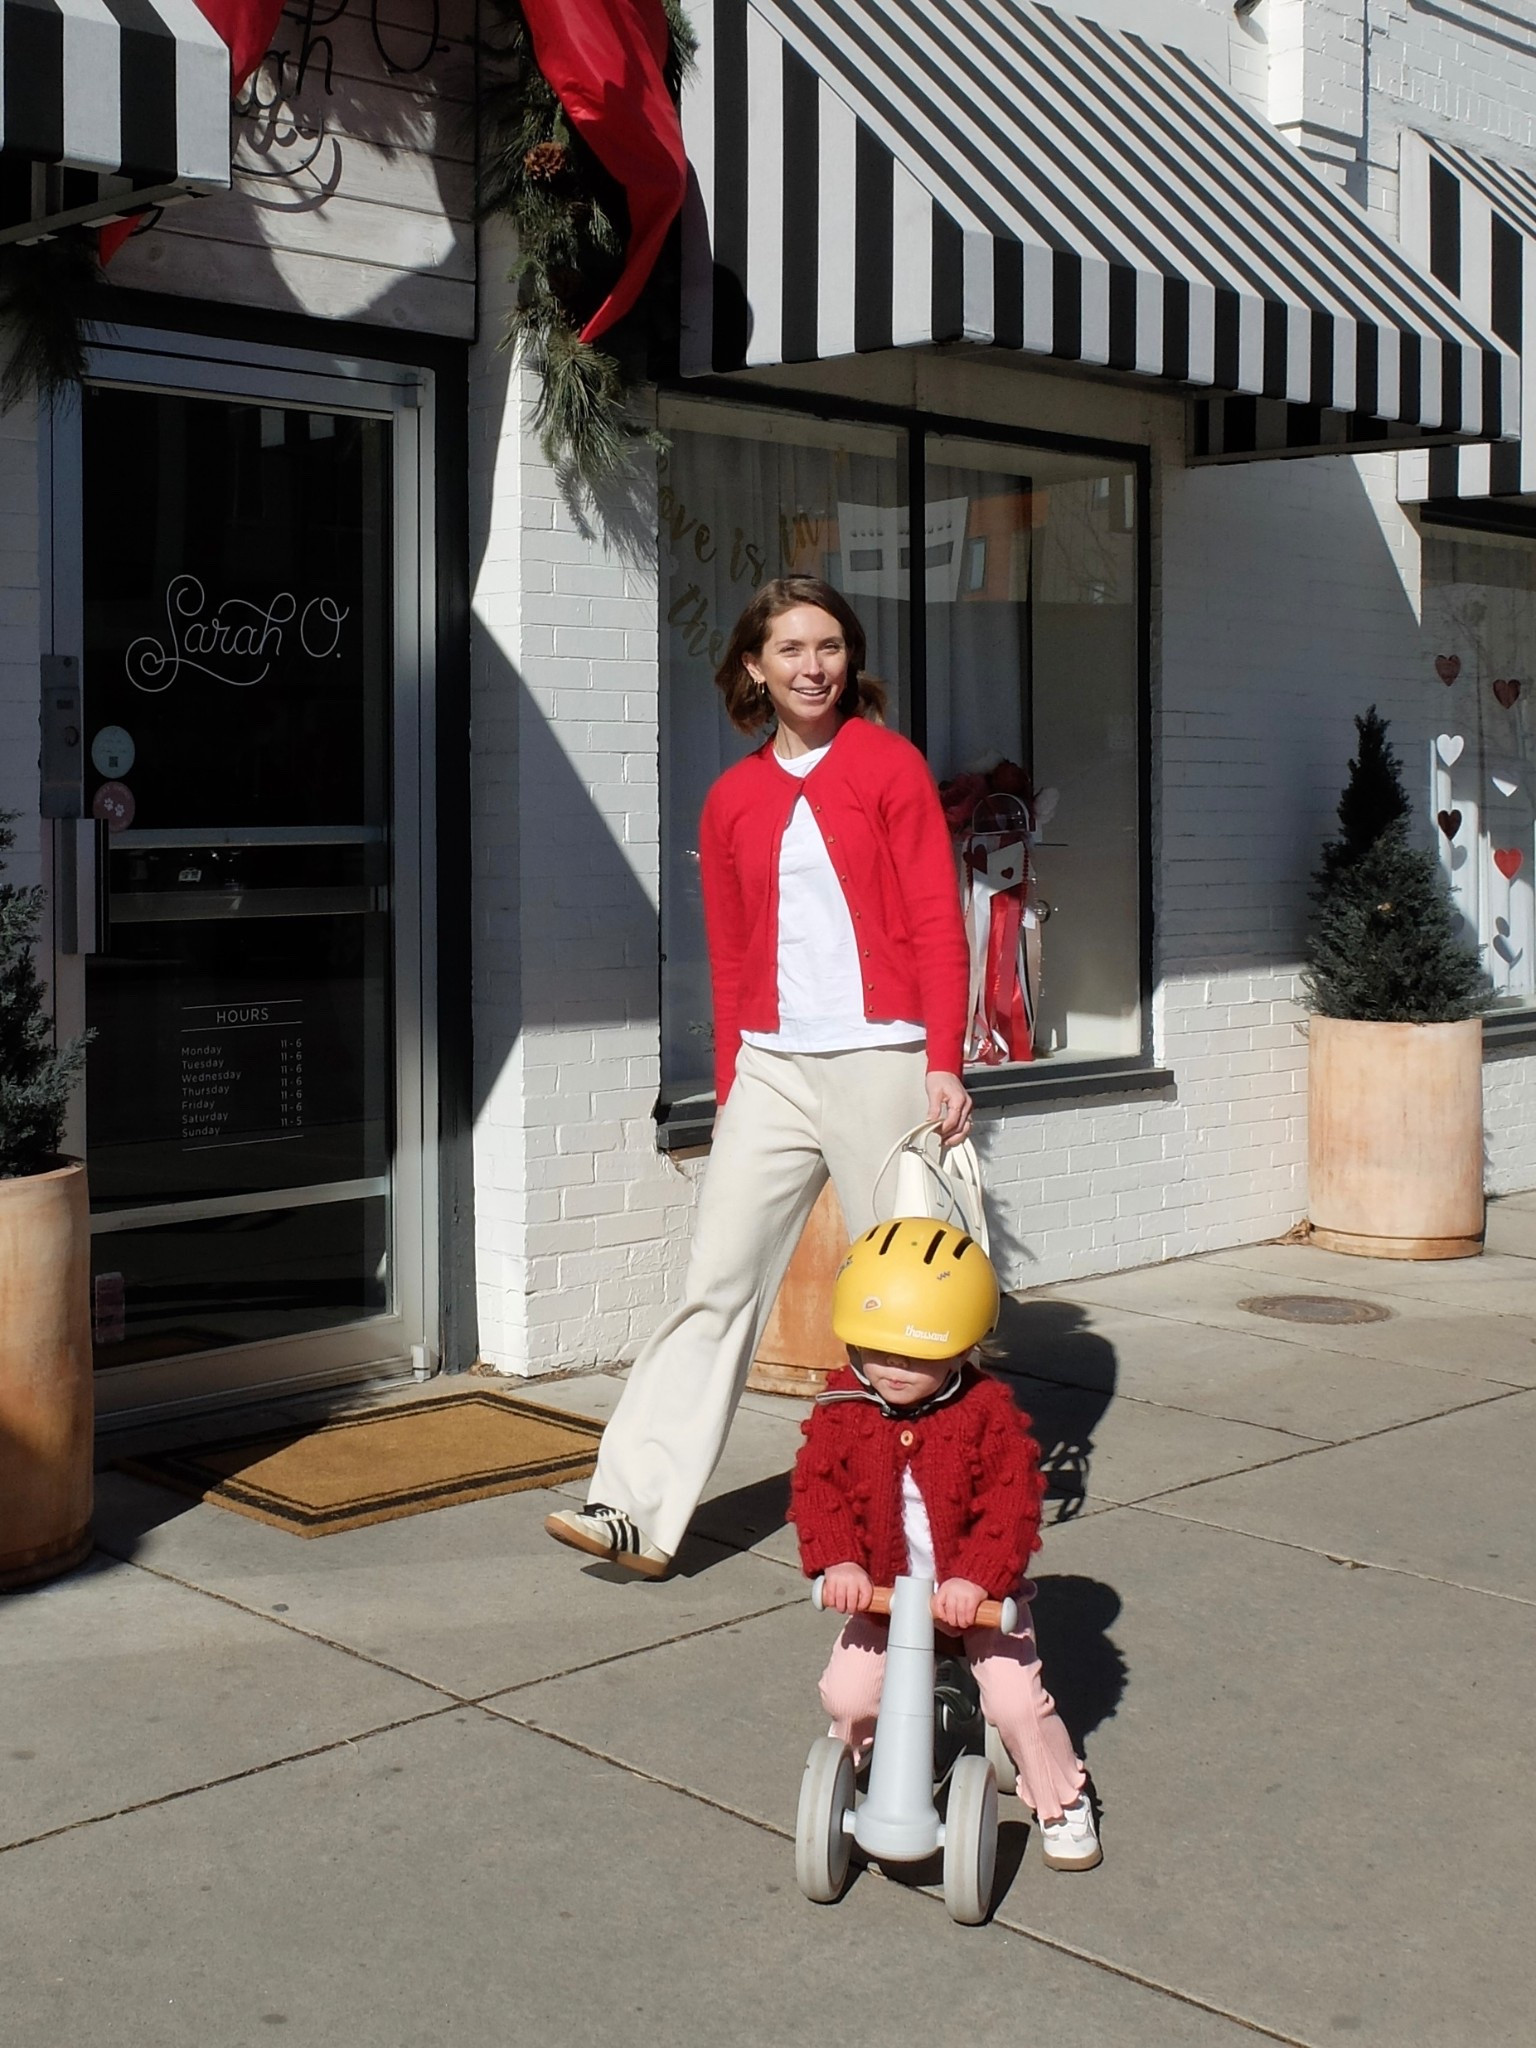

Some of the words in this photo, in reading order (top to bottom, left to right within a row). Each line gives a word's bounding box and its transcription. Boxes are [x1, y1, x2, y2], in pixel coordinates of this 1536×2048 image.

[730, 527, 766, 587] is
[667, 582, 724, 667] the
[125, 574, 297, 693] Sarah
[216, 1007, 270, 1024] HOURS
[181, 1045, 222, 1056] Monday
[181, 1058, 224, 1070] Tuesday
[181, 1070, 242, 1083] Wednesday
[182, 1084, 230, 1097] Thursday
[181, 1099, 215, 1110] Friday
[181, 1111, 229, 1125] Saturday
[182, 1126, 221, 1138] Sunday
[905, 1325, 950, 1343] thousand
